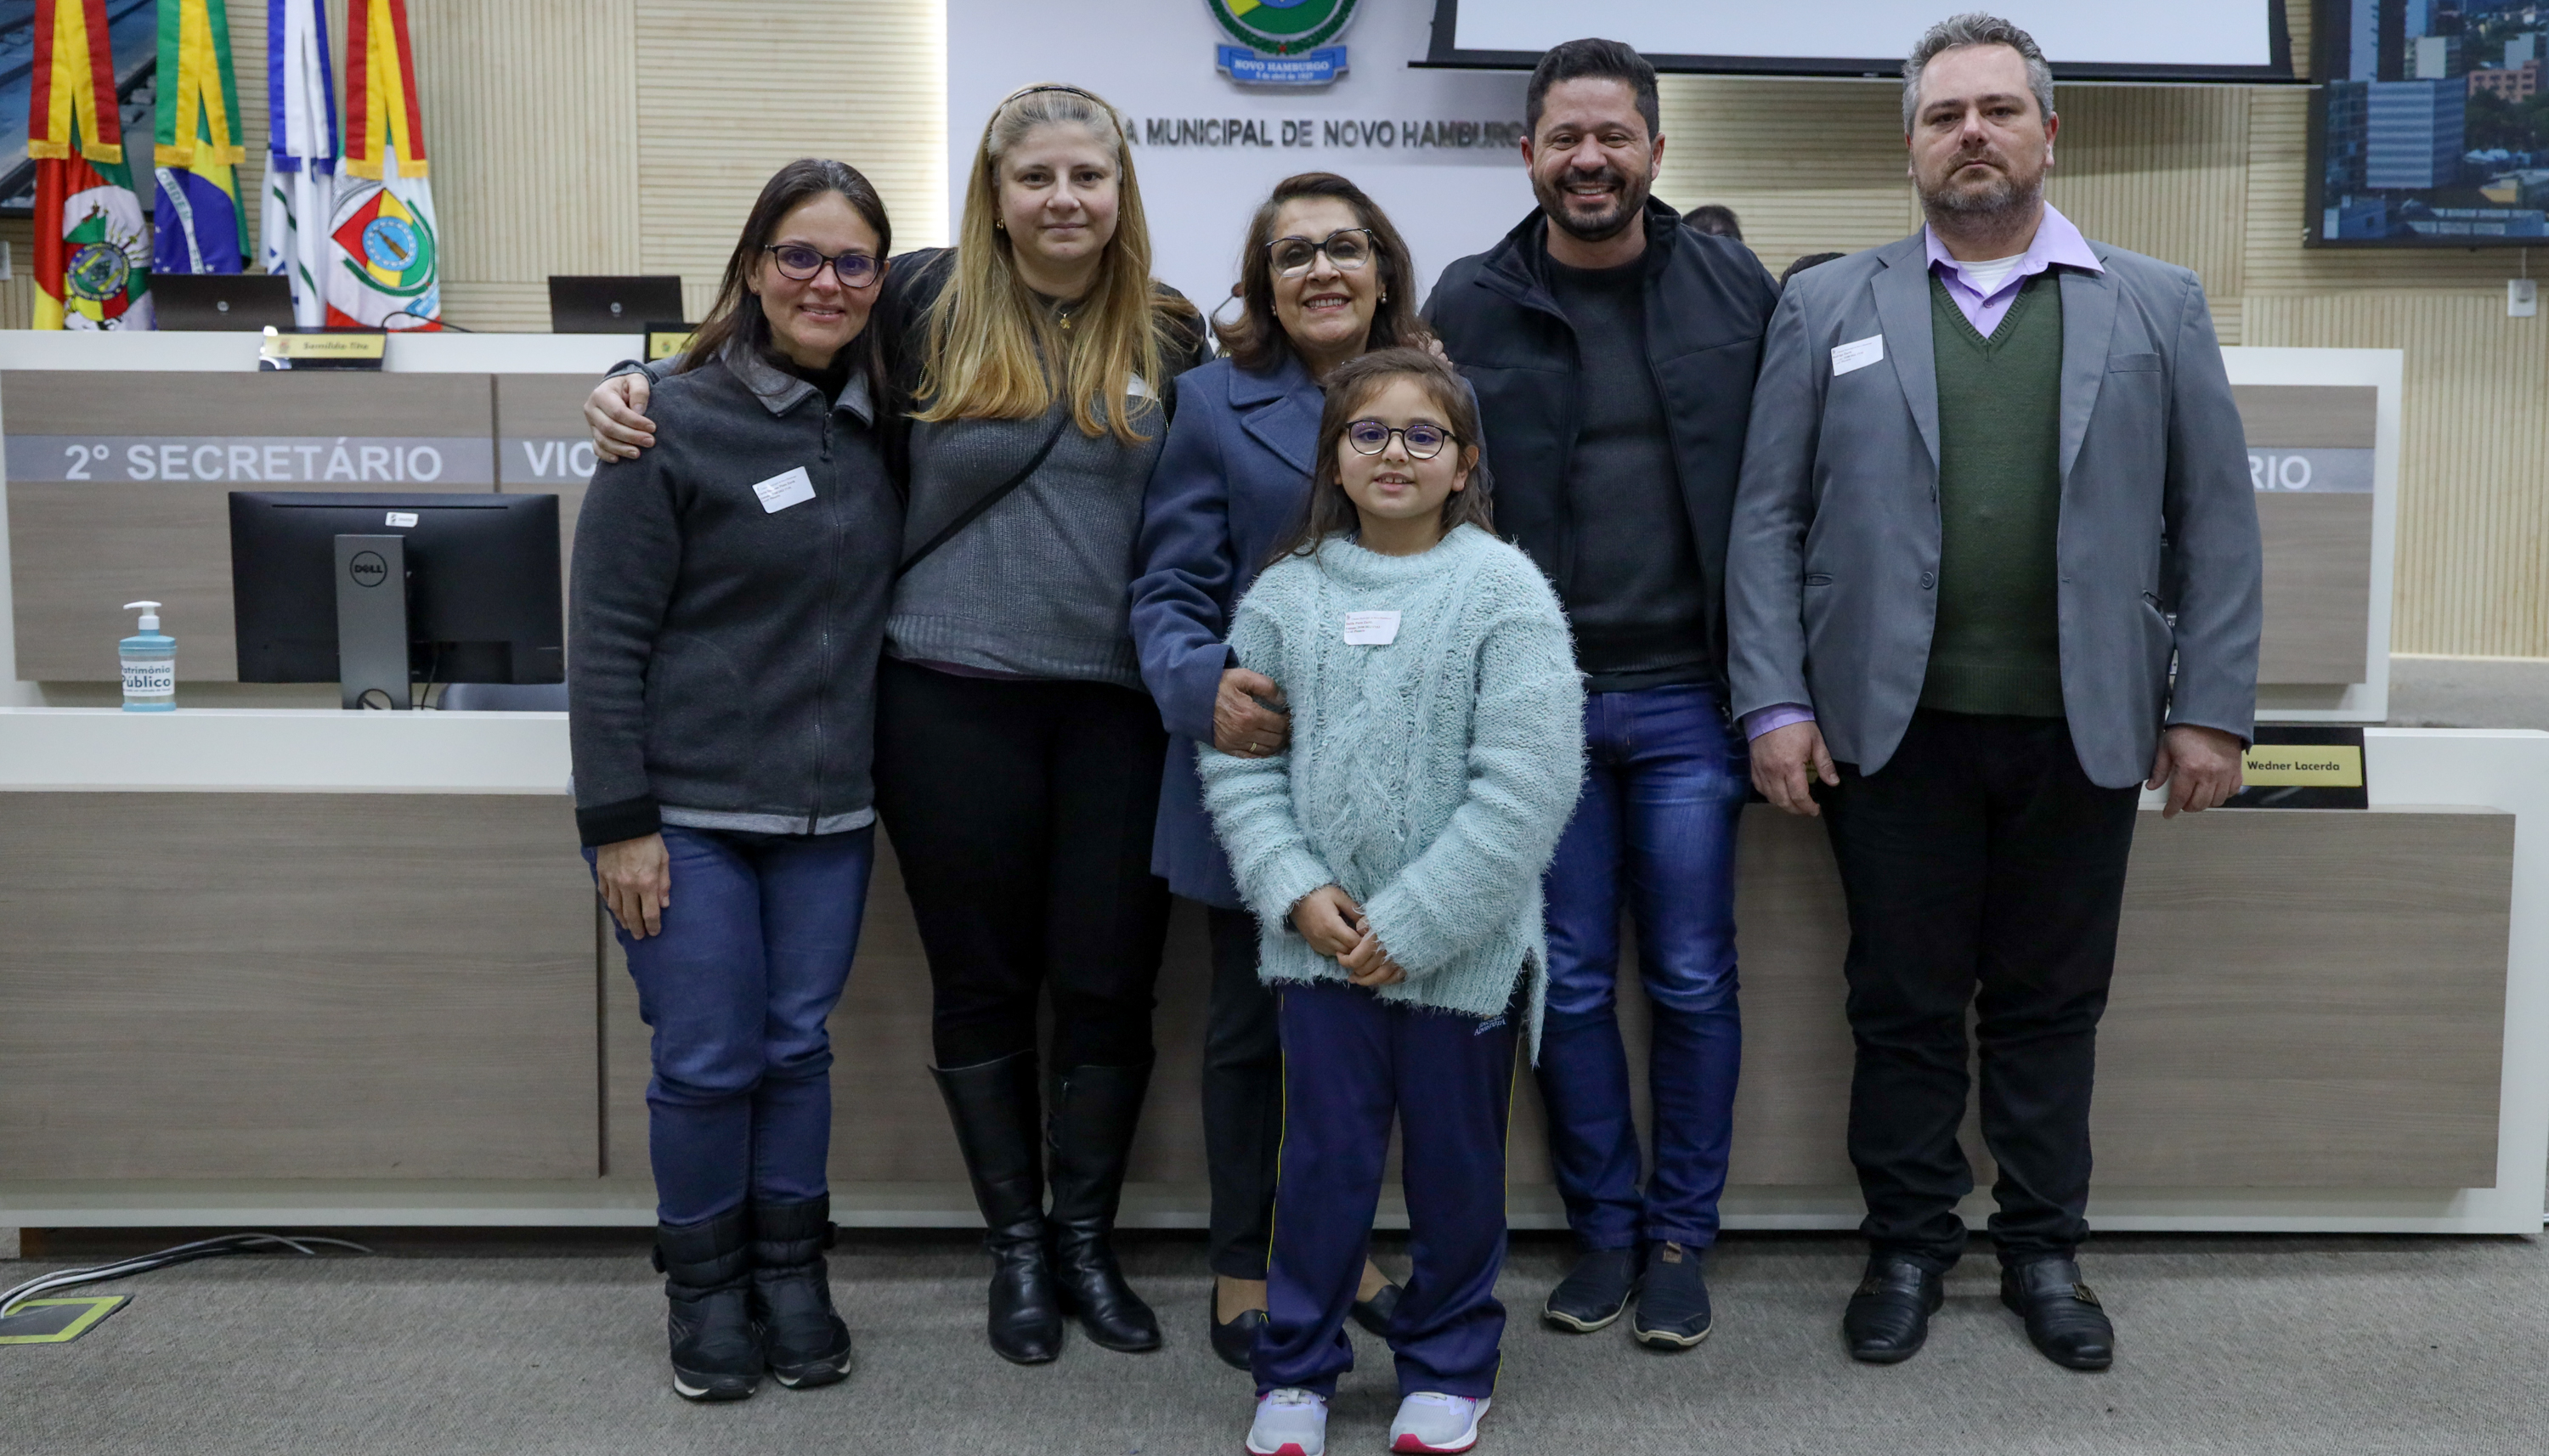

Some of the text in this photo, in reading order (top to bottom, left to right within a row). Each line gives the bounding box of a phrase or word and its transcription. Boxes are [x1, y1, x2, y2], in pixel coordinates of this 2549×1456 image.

[1234, 59, 1330, 71] NOVO HAMBURGO
[1146, 118, 1274, 147] MUNICIPAL
[1282, 119, 1313, 147] DE
[1324, 120, 1395, 148] NOVO
[1402, 120, 1529, 148] HAMBURG
[127, 437, 443, 482] SECRETÁRIO
[354, 564, 383, 573] DELL
[2247, 760, 2340, 770] Wedner Lacerda
